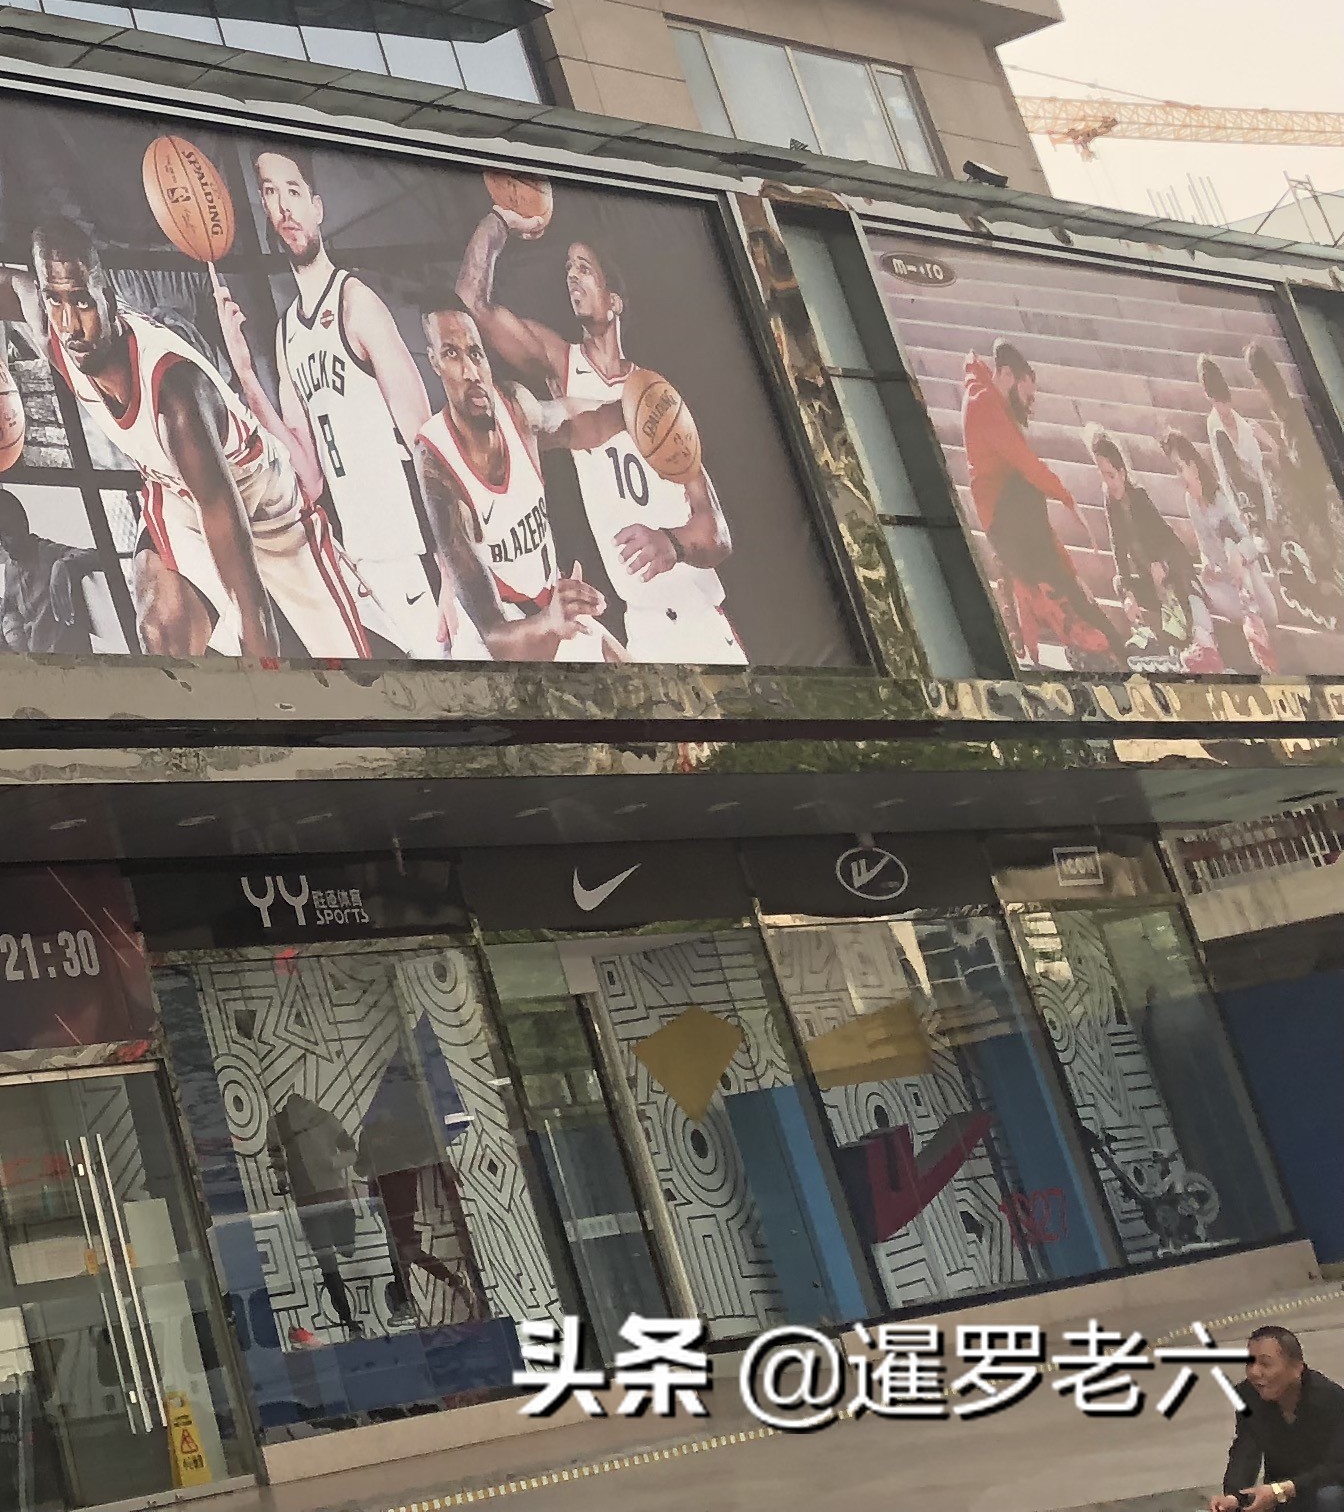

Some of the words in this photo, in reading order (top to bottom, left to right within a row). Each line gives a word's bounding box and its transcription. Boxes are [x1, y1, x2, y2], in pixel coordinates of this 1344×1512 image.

[182, 150, 223, 236] SPALDING
[605, 447, 649, 506] 10
[487, 497, 548, 562] BLAZERS
[0, 929, 100, 981] 21:30
